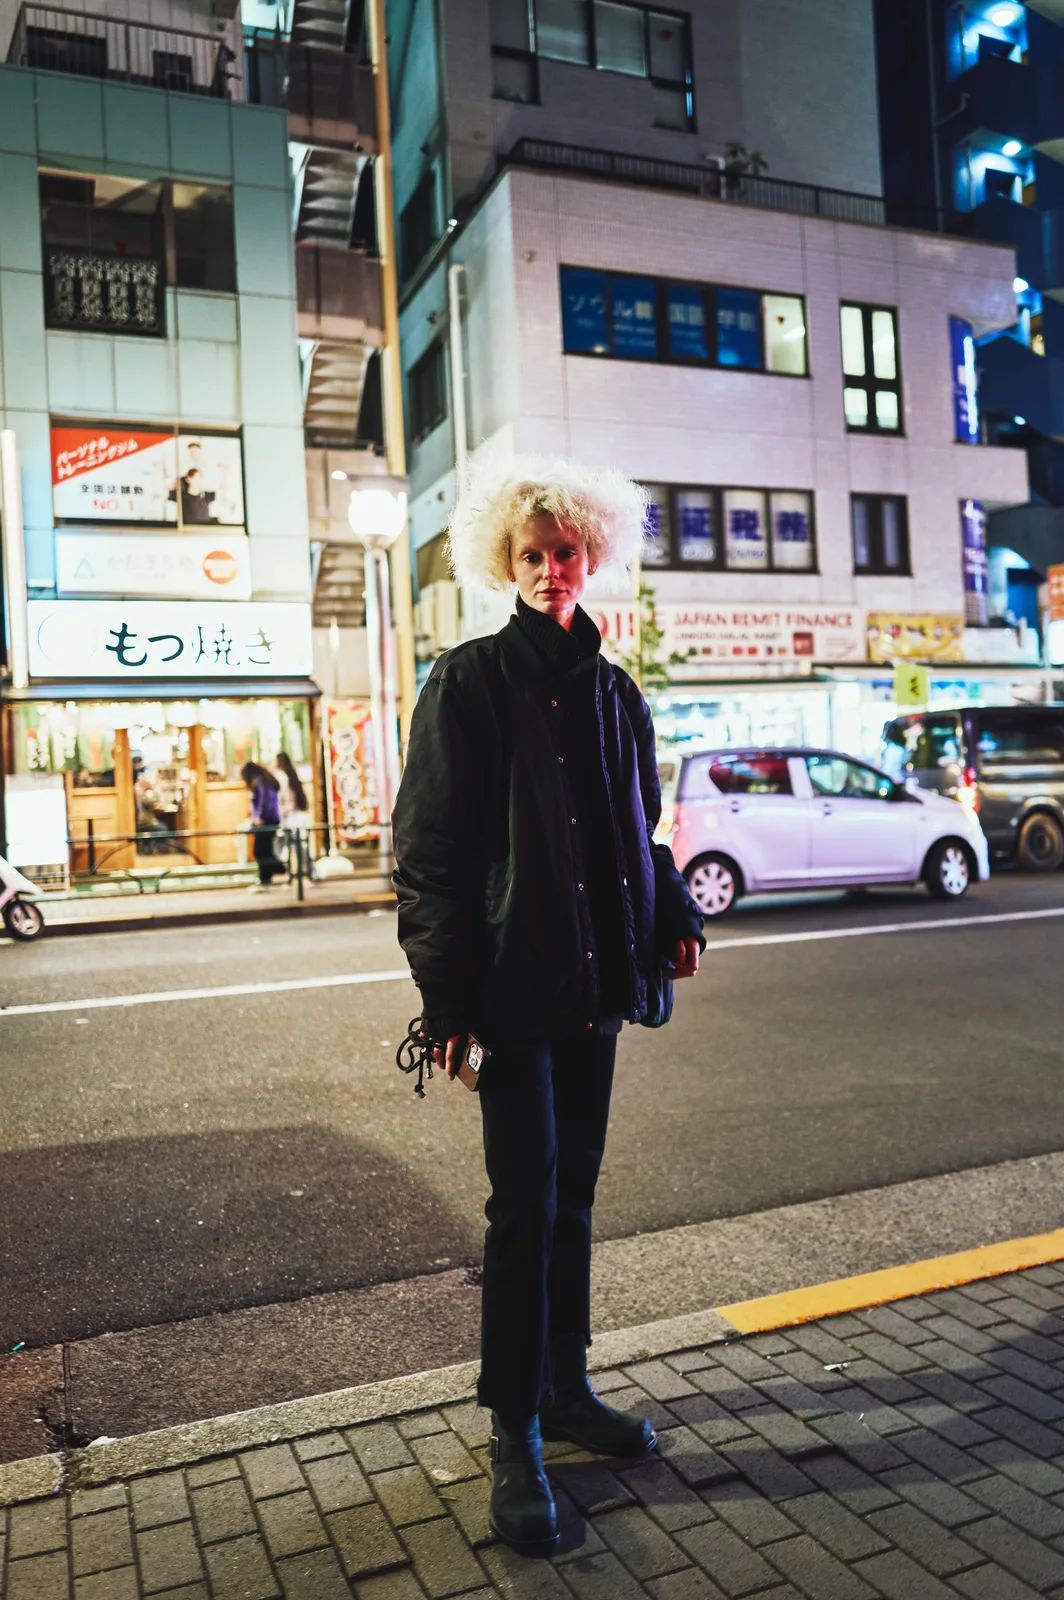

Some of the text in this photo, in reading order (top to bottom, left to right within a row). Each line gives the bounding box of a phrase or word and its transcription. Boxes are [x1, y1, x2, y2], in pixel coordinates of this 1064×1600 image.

[56, 436, 110, 466] パーソナル
[58, 438, 139, 480] トレーニングジム
[675, 612, 852, 627] JAPAN REMIT FINANCE
[105, 621, 276, 667] もつ焼き
